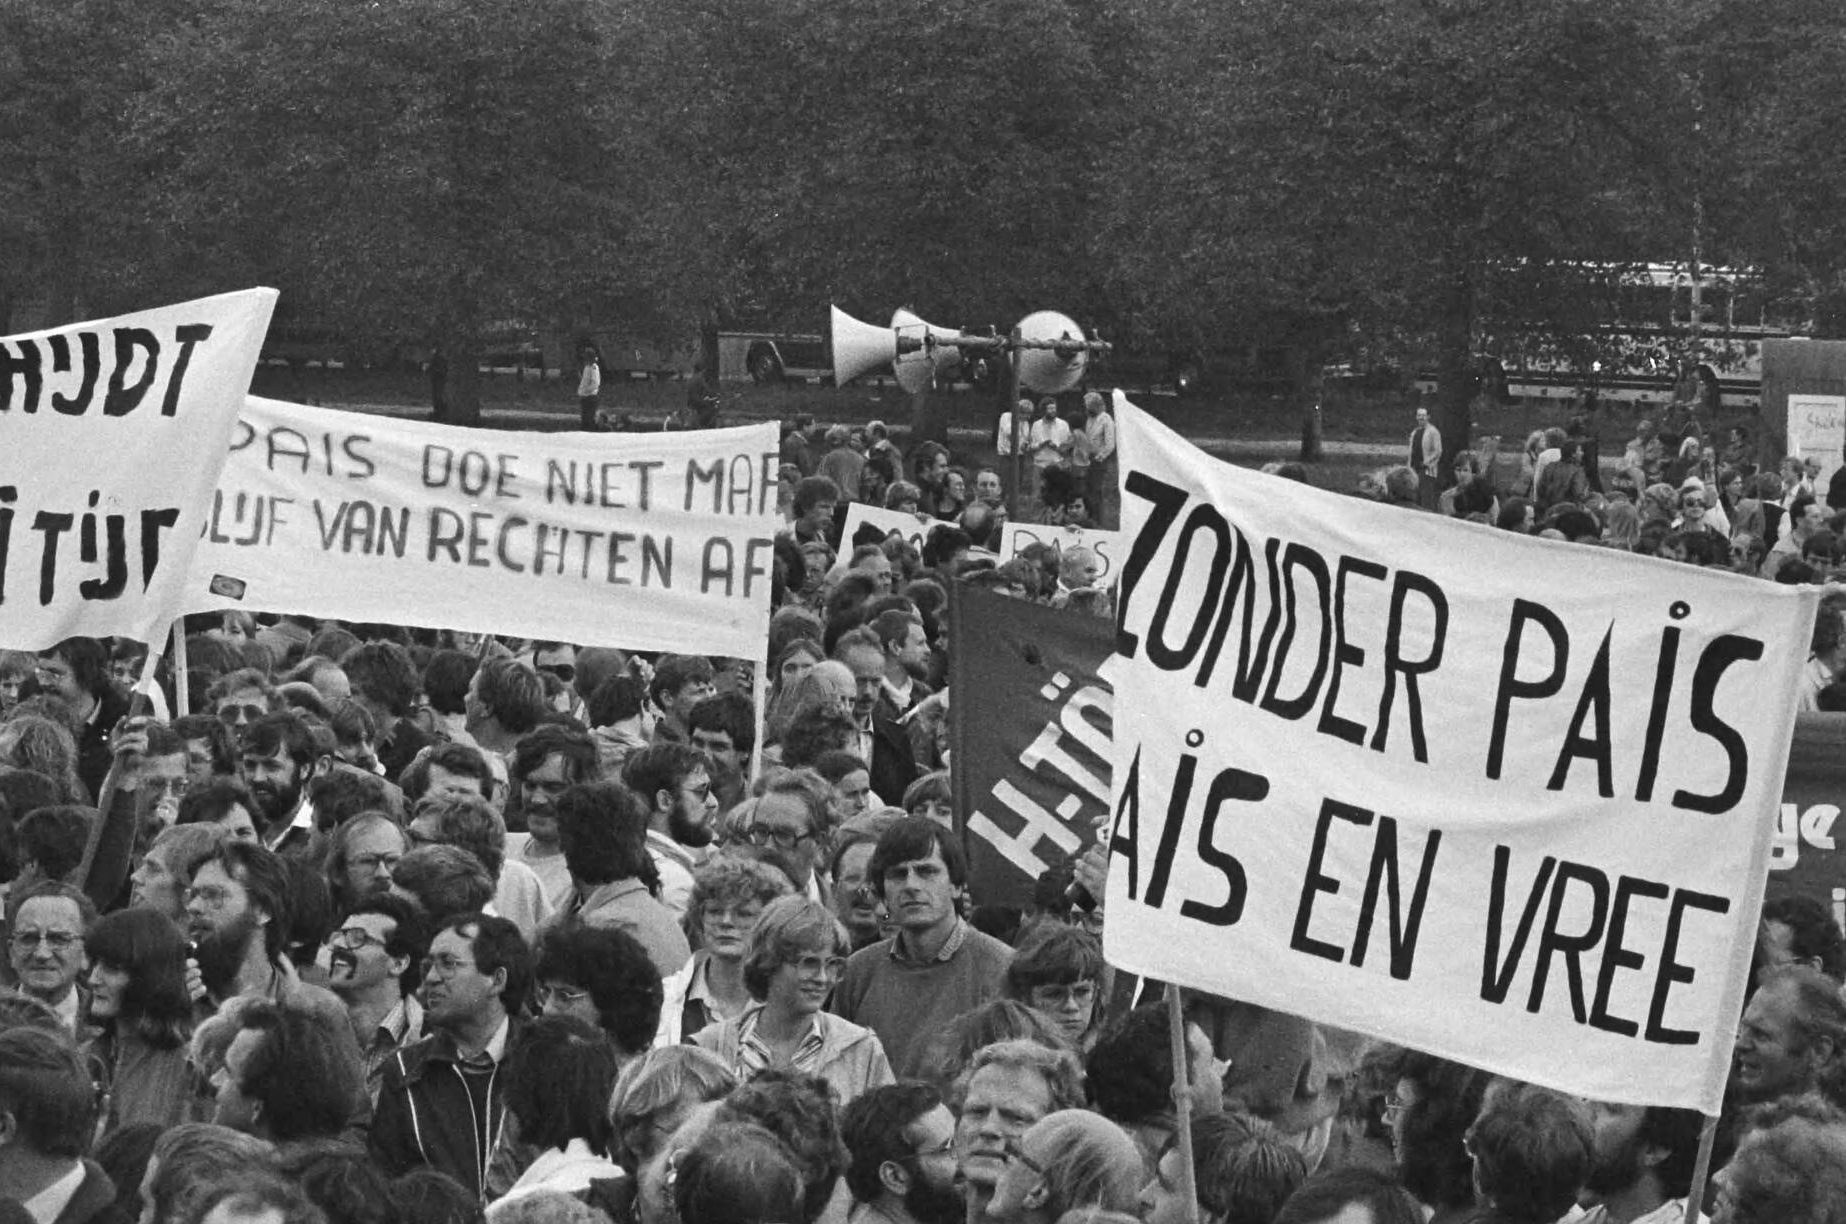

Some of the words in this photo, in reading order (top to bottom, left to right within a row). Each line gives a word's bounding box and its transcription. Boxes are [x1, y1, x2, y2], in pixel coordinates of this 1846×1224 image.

[201, 488, 296, 547] LIJF
[312, 500, 410, 558] VAN
[426, 505, 676, 590] RECHTEN
[700, 535, 775, 599] AF
[423, 443, 521, 499] DOE
[547, 459, 665, 511] NIET
[1113, 469, 1449, 765] ZONDER
[1288, 796, 1444, 982] EN
[1479, 843, 1732, 1047] VREE
